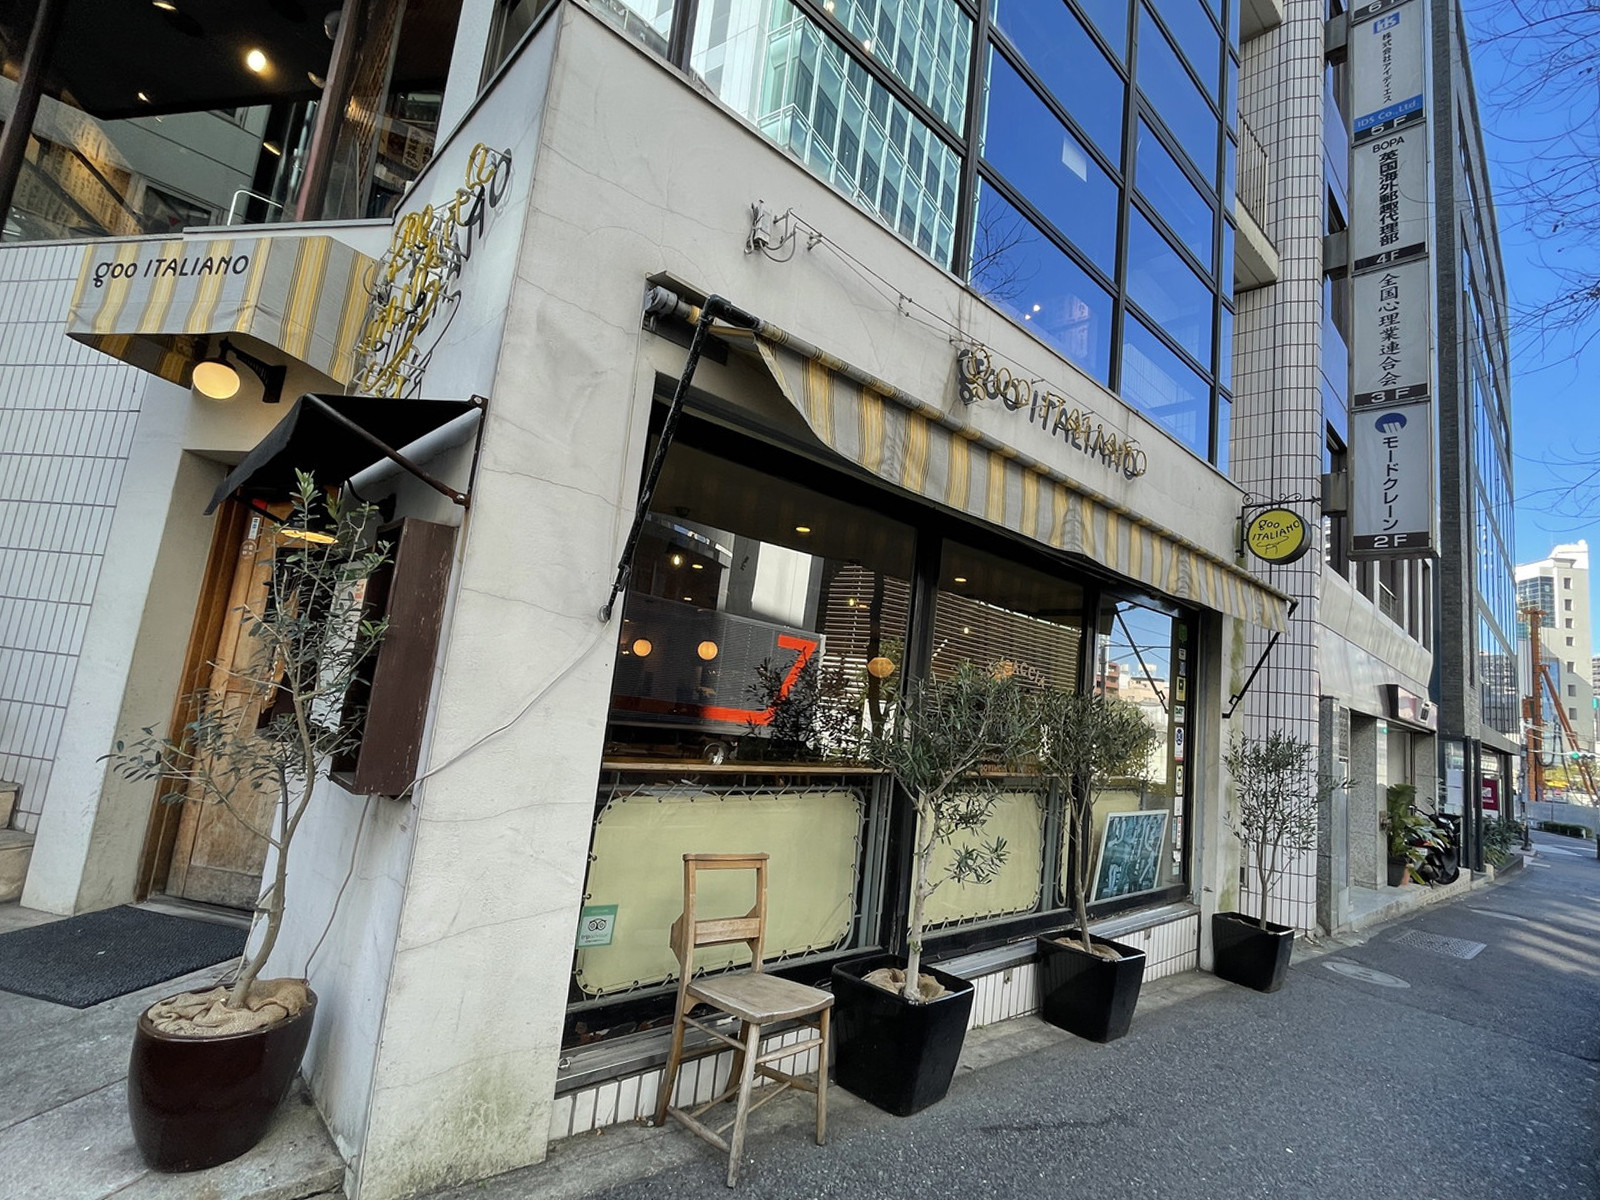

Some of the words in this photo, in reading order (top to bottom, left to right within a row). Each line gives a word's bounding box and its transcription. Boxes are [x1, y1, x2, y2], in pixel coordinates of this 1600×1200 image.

[1369, 0, 1395, 13] 6
[1382, 32, 1392, 104] 株式会社アイディエス
[1357, 115, 1375, 128] IDS
[1371, 114, 1408, 135] 5F
[1372, 136, 1405, 153] BOPA
[1379, 148, 1399, 247] 英国海外郵趣代理部
[1376, 249, 1400, 264] 4F
[93, 262, 138, 288] goo
[143, 255, 249, 278] ITALIANO
[1378, 273, 1401, 387] 全国心理業連合会
[1371, 387, 1410, 404] 3F
[1029, 390, 1147, 481] ITALIANO
[1382, 436, 1399, 531] モードクレーン
[1252, 519, 1300, 541] ITALIANO
[1258, 519, 1280, 531] goo
[1373, 534, 1408, 549] 2F
